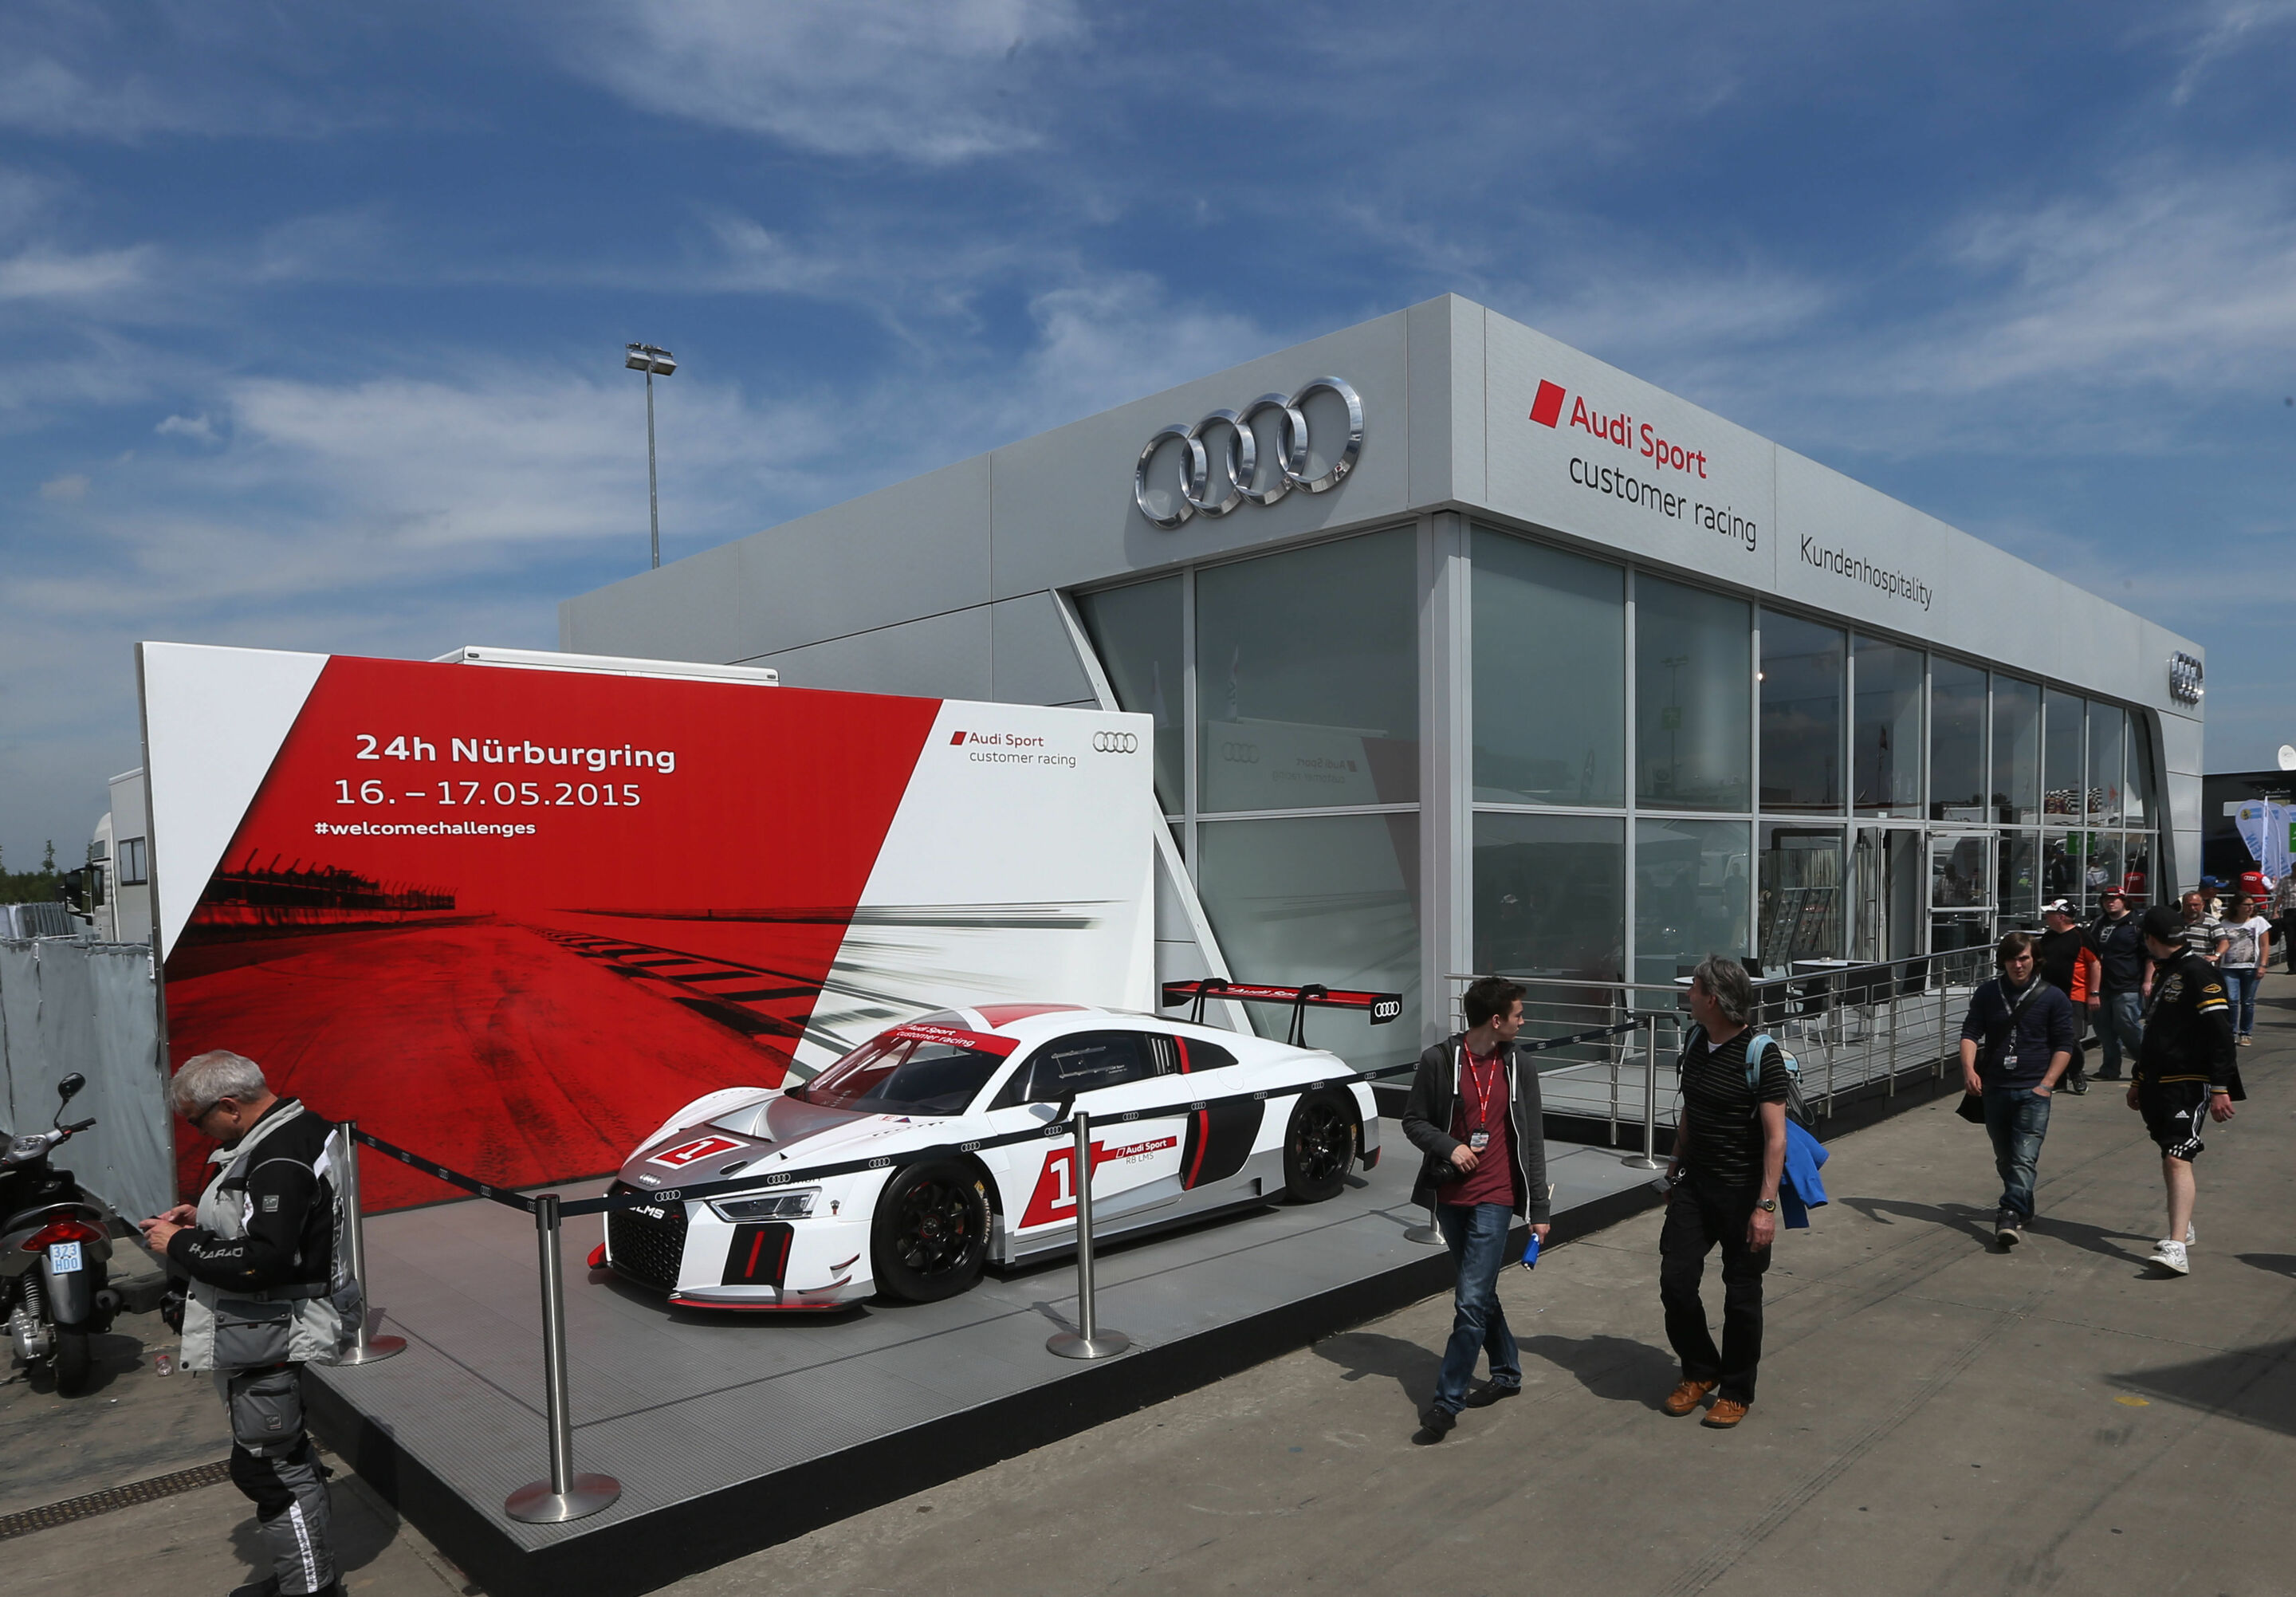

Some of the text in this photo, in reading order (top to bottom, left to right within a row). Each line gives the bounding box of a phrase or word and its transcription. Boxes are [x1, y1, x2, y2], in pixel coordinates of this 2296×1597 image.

[1570, 396, 1707, 479] Audi Sport
[1569, 456, 1757, 552] customer racing
[1800, 533, 1932, 612] Kundenhospitality
[969, 732, 1044, 748] Audi Sport
[356, 734, 676, 774] 24h Nürburgring
[969, 751, 1076, 769] customer racing
[335, 779, 396, 804] 16.
[314, 821, 537, 838] #welcomechallenges
[896, 1031, 976, 1048] customer racing
[926, 1027, 957, 1036] Sport
[675, 1140, 715, 1160] 1
[1126, 1139, 1167, 1155] Audi Sport
[1126, 1152, 1154, 1165] R8 LMS
[1050, 1157, 1077, 1210] 1
[982, 1198, 991, 1245] MICHELIN
[53, 1244, 77, 1258] 323
